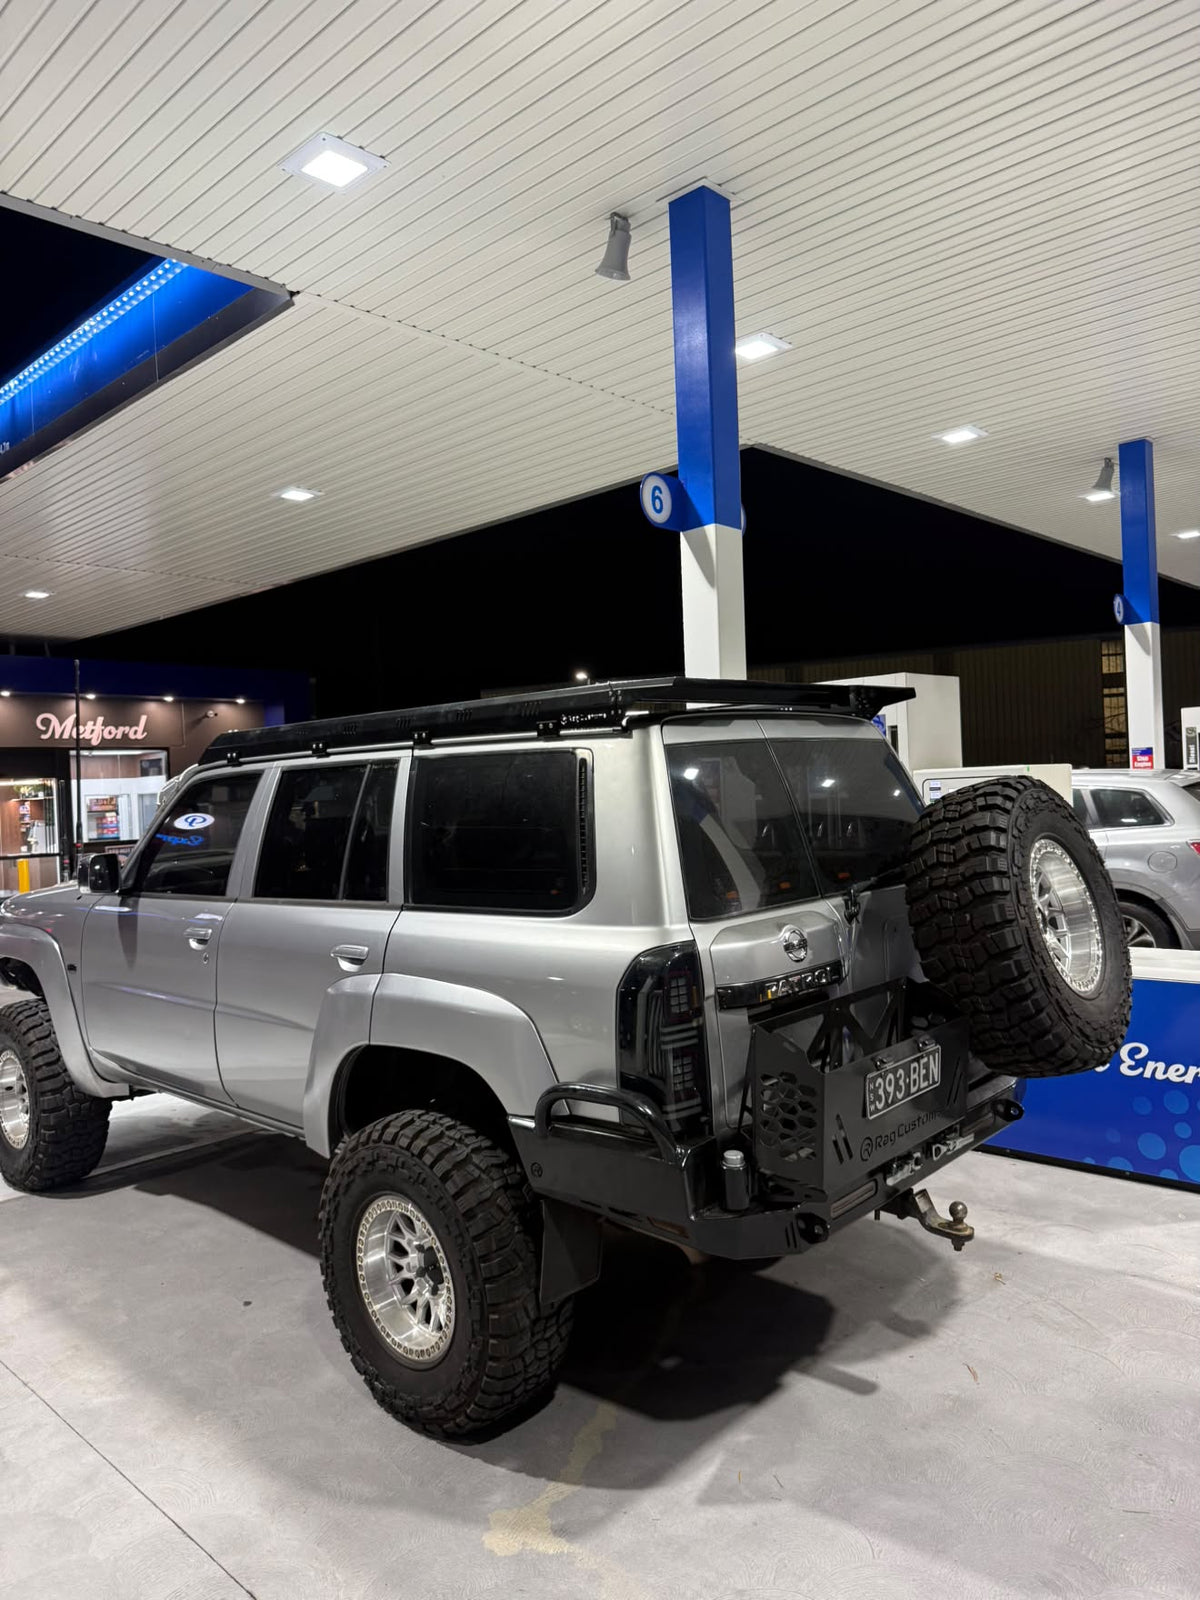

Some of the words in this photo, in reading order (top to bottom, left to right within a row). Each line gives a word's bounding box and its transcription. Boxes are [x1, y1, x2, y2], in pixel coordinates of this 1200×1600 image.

[651, 485, 663, 514] 6
[36, 713, 147, 746] Metford
[874, 1131, 896, 1151] Rag
